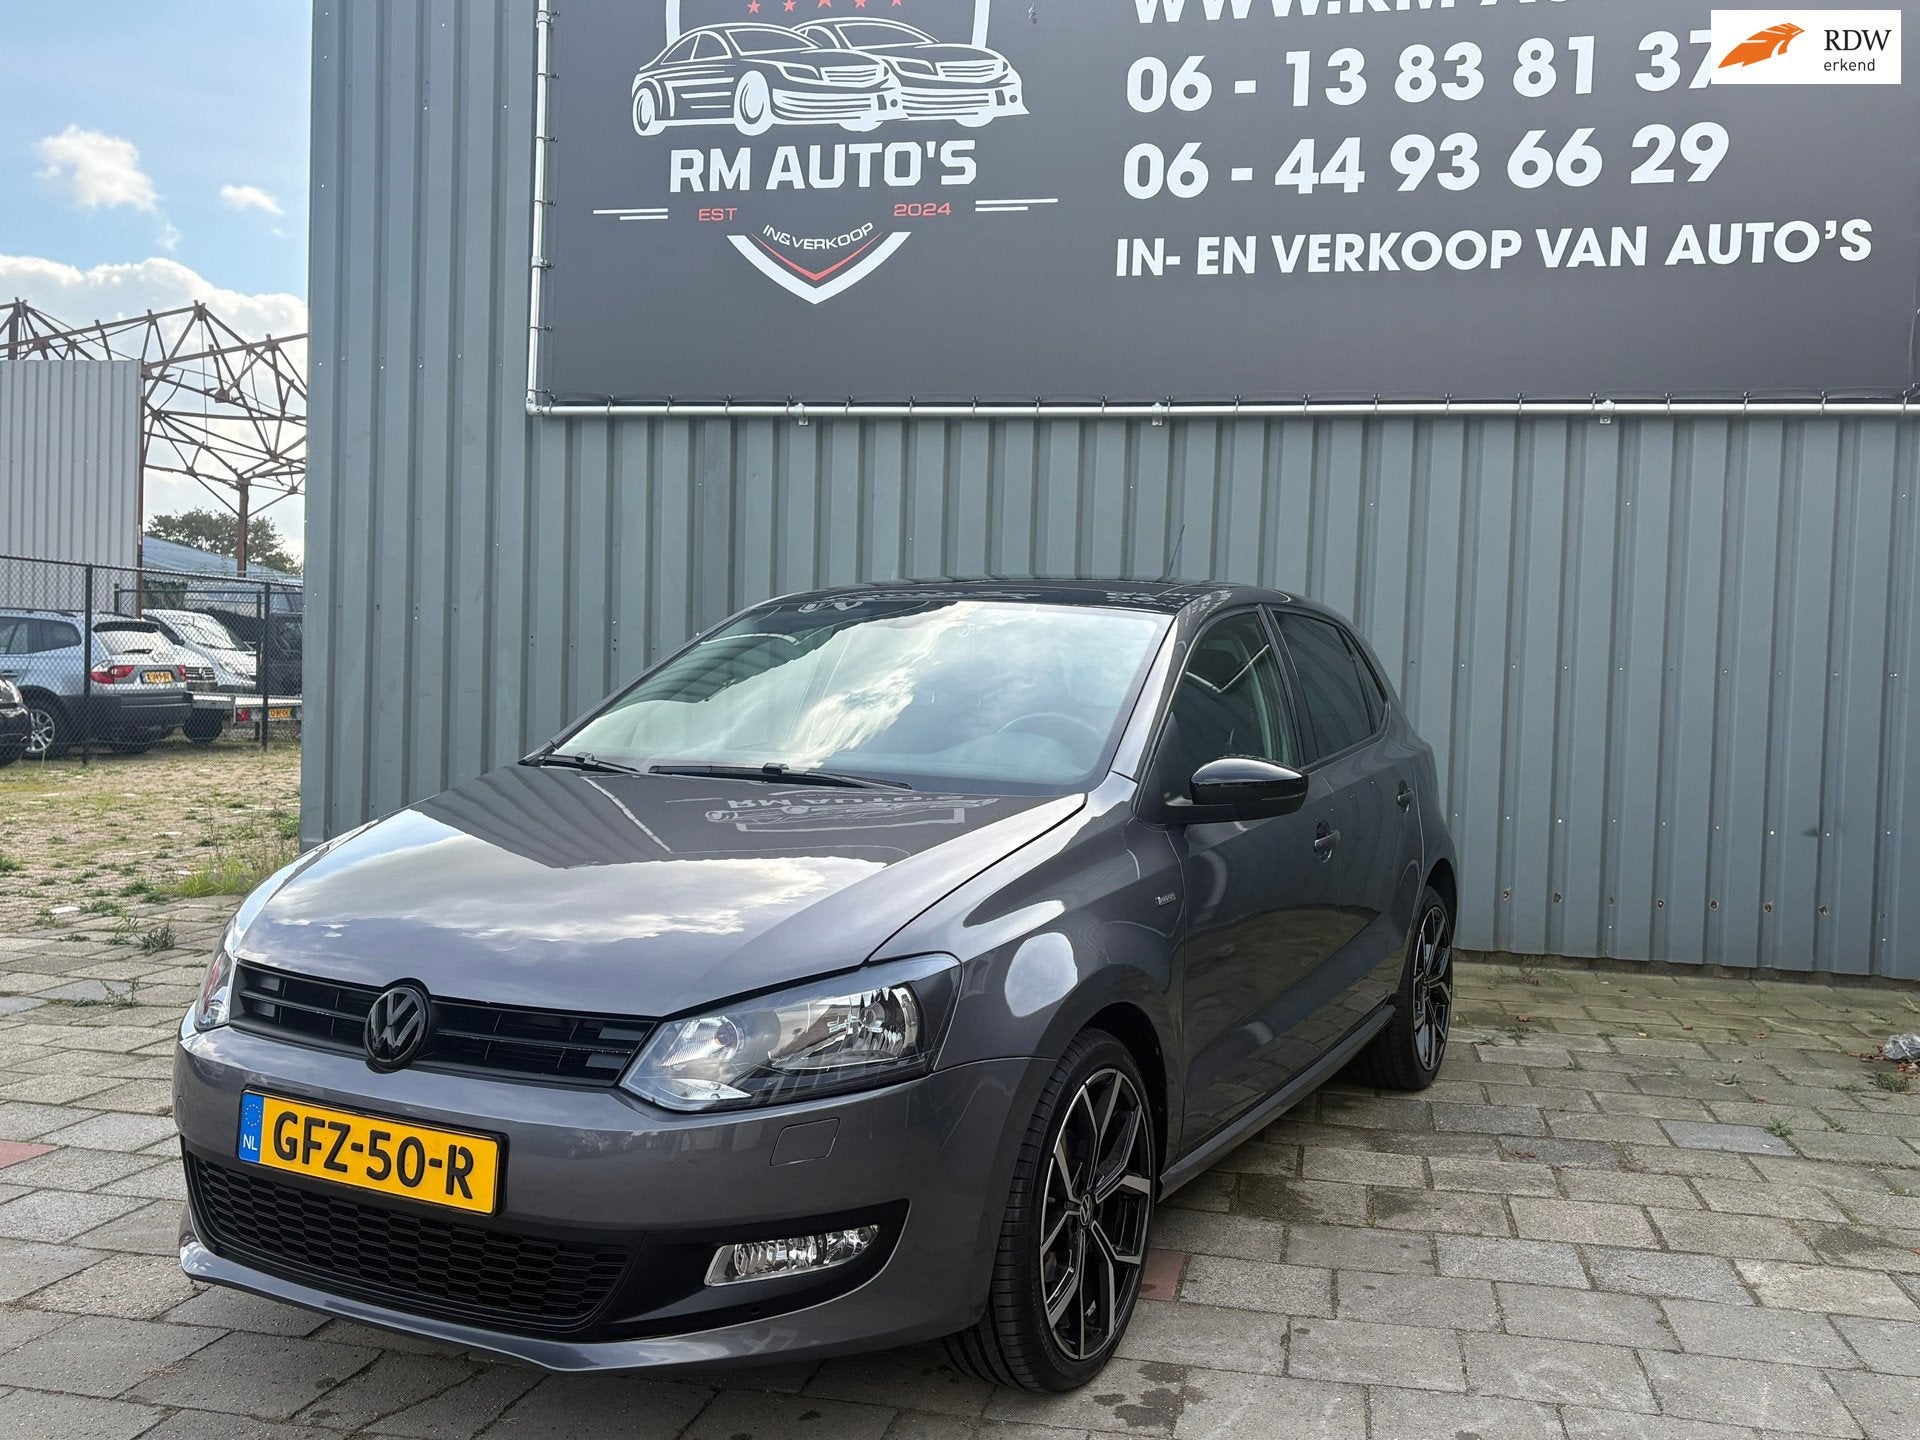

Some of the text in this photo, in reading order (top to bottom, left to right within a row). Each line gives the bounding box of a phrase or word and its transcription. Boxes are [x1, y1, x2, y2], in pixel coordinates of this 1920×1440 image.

[1127, 29, 1711, 114] 06 - 13 83 81 37
[669, 139, 977, 193] RM AUTO'S
[1123, 121, 1730, 200] 06 - 44 93 66 29
[698, 202, 952, 221] EST 2024
[762, 222, 874, 250] IN&VERKOOP
[1115, 218, 1873, 277] IN- EN VERKOOP VAN AUTO'S
[242, 1134, 258, 1151] NL
[273, 1111, 474, 1200] GFZ-50-R
